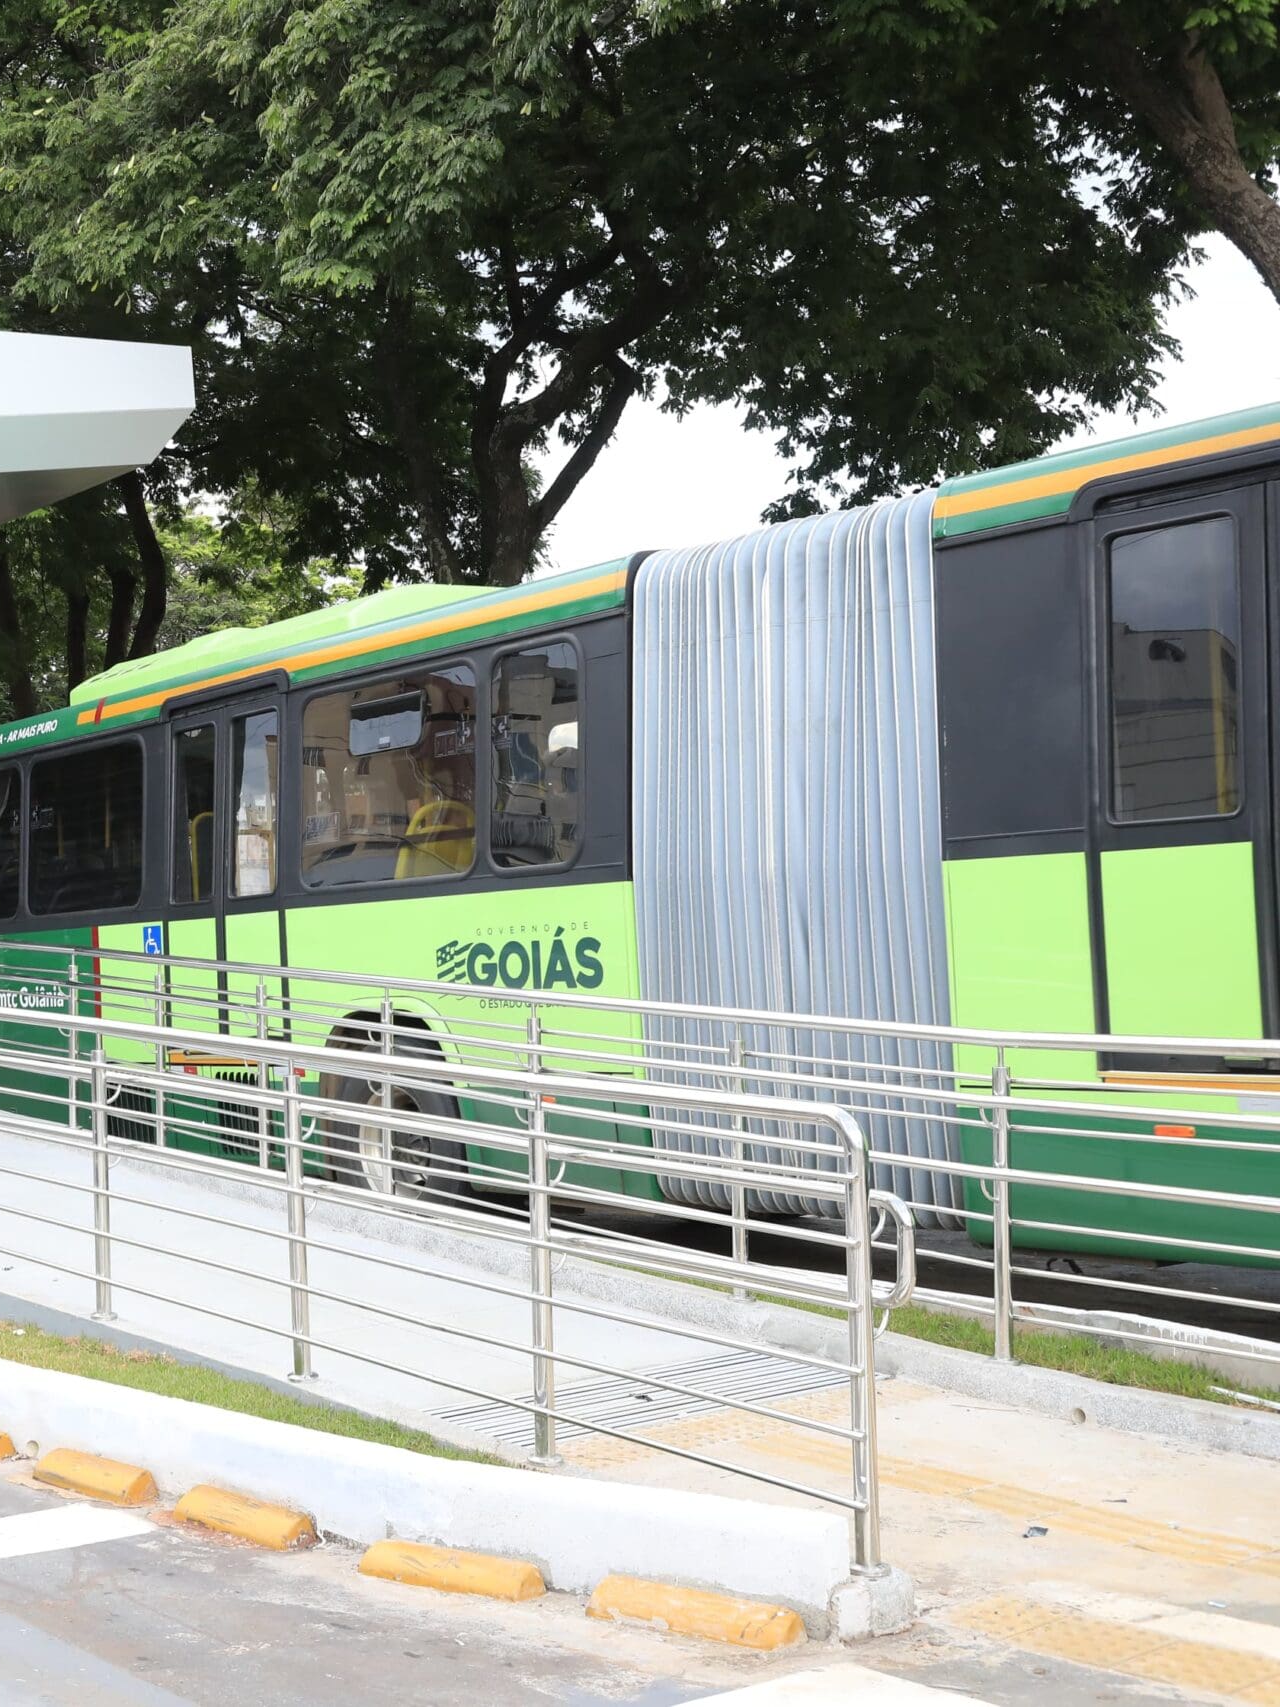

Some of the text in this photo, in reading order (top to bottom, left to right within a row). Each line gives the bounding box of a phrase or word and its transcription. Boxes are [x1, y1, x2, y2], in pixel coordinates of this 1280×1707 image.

[7, 730, 18, 743] AR
[16, 725, 36, 741] MAIS
[35, 720, 58, 737] PURO
[476, 921, 589, 937] GOVERNO DE
[467, 926, 604, 989] GOIÁS
[19, 985, 65, 1008] Goiânia
[480, 999, 487, 1009] O
